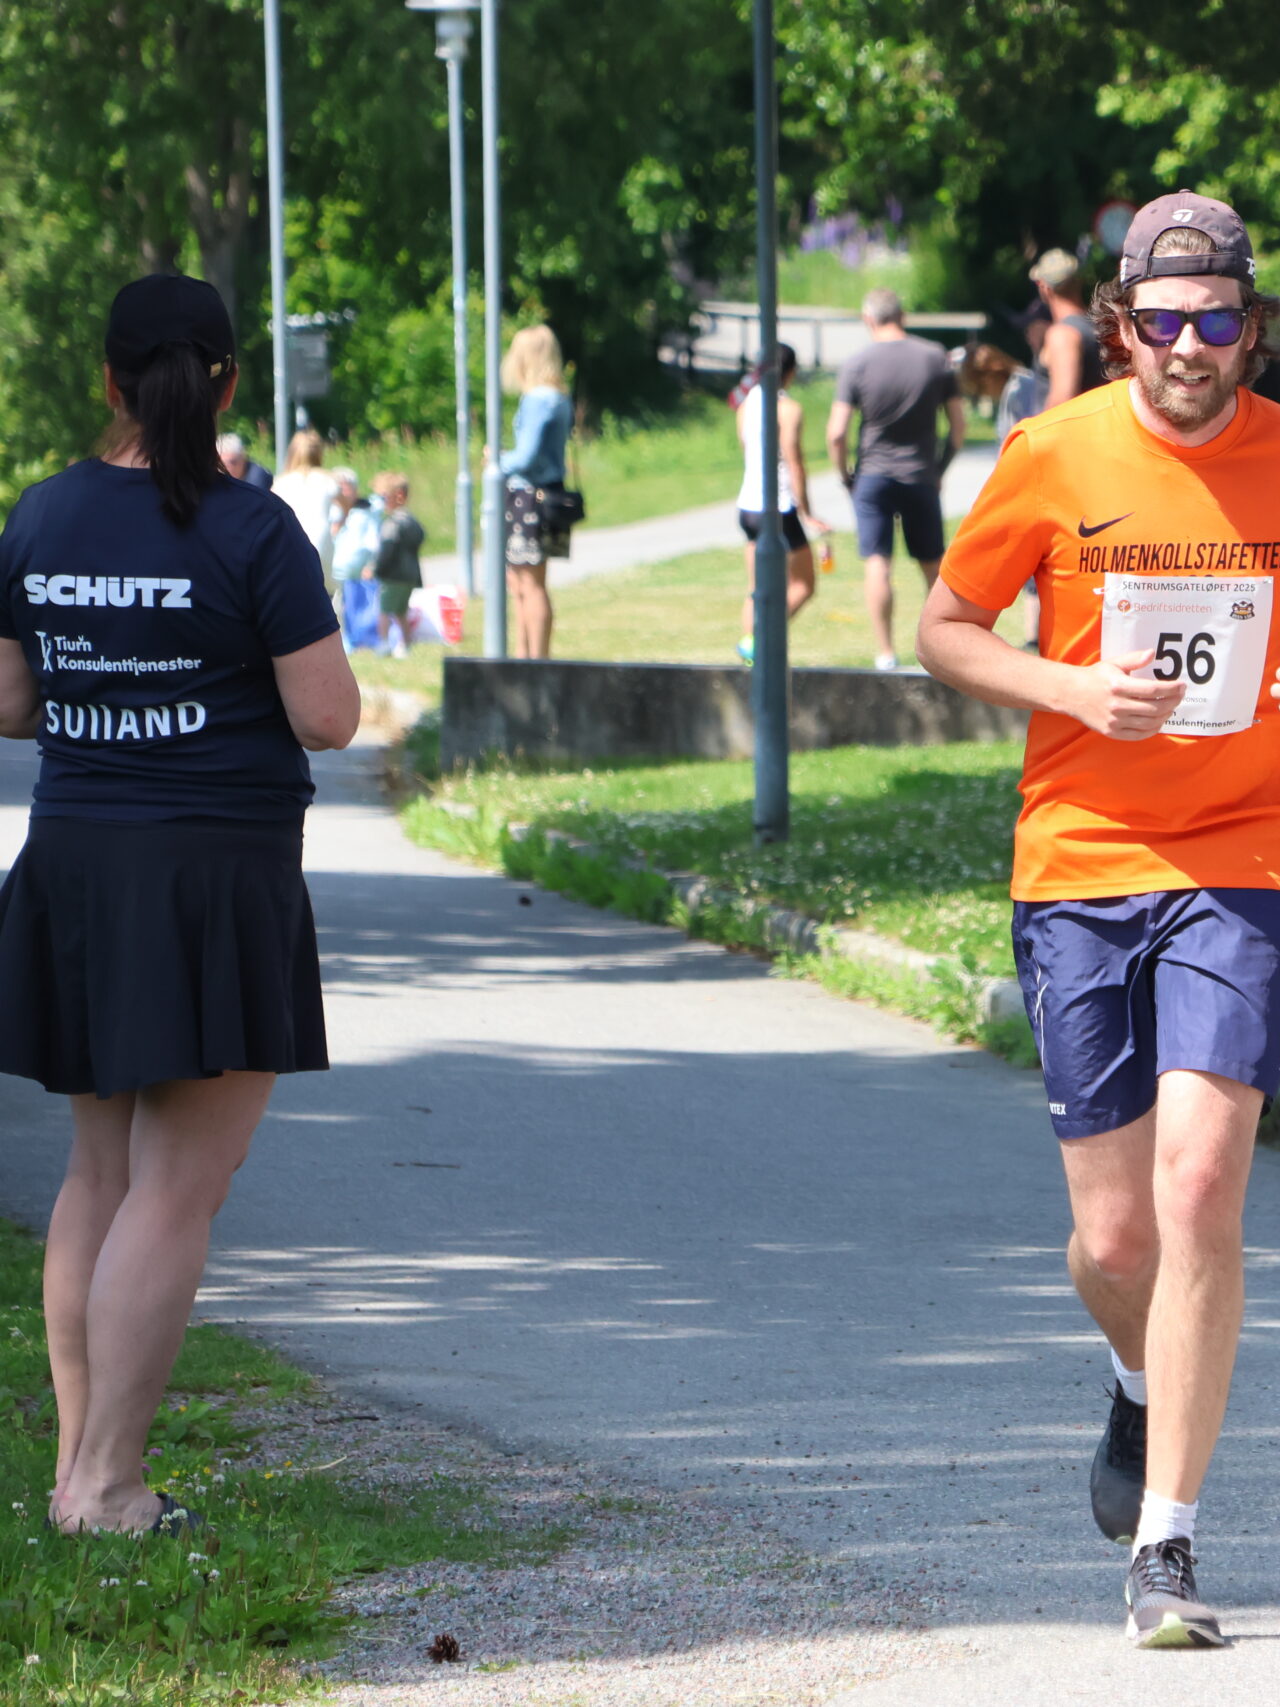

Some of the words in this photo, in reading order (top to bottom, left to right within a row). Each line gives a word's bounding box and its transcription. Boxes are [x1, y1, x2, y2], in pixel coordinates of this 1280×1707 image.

[24, 574, 192, 608] SCHÜTZ
[1122, 581, 1230, 592] SENTRUMSGATELØPET
[1233, 584, 1256, 592] 2025
[1134, 602, 1212, 614] Bedriftsidretten
[57, 655, 202, 676] Konsulenttjenester
[1153, 632, 1216, 685] 56
[1165, 718, 1236, 729] nsulenttjenester
